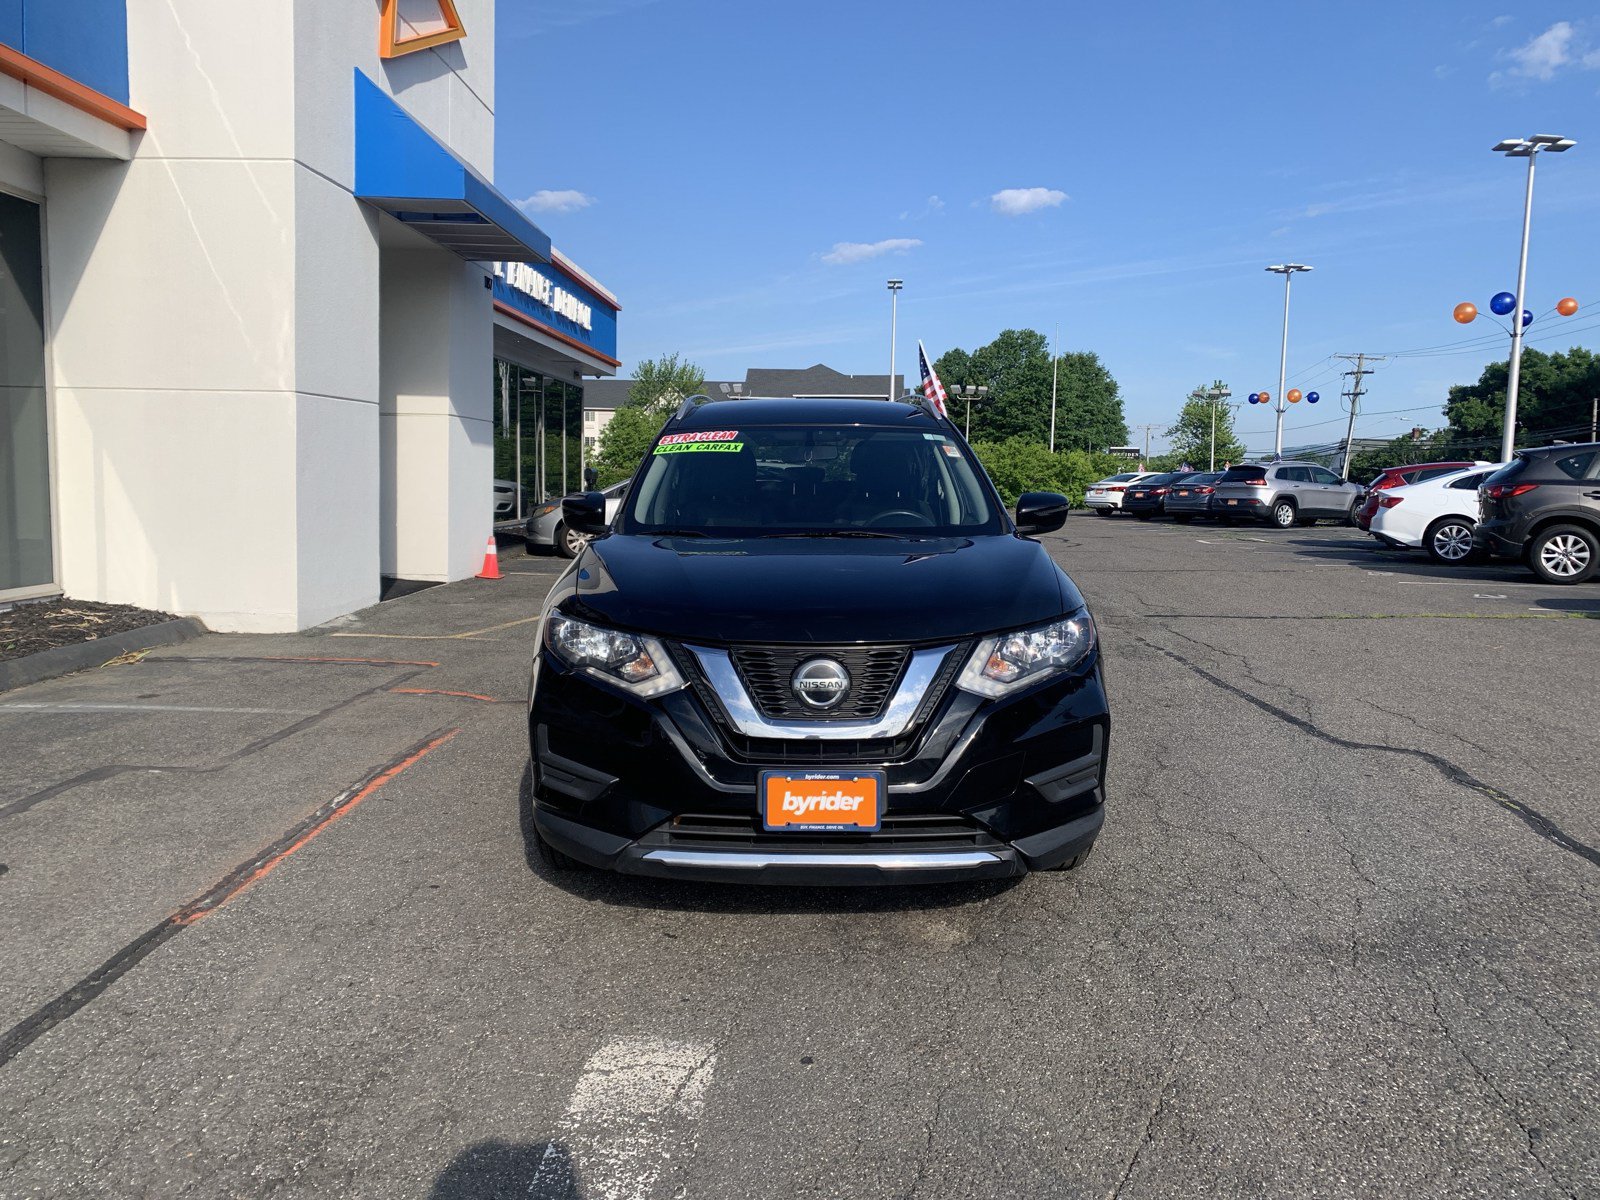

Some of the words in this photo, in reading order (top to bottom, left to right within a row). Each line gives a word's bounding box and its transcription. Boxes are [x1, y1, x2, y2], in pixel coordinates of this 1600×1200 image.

[659, 433, 698, 445] EXTRA
[699, 431, 738, 441] CLEAN
[656, 444, 693, 453] CLEAN
[696, 443, 740, 451] CARFAX
[799, 681, 843, 689] NISSAN
[805, 773, 840, 781] byrider.com
[782, 791, 864, 816] byrider
